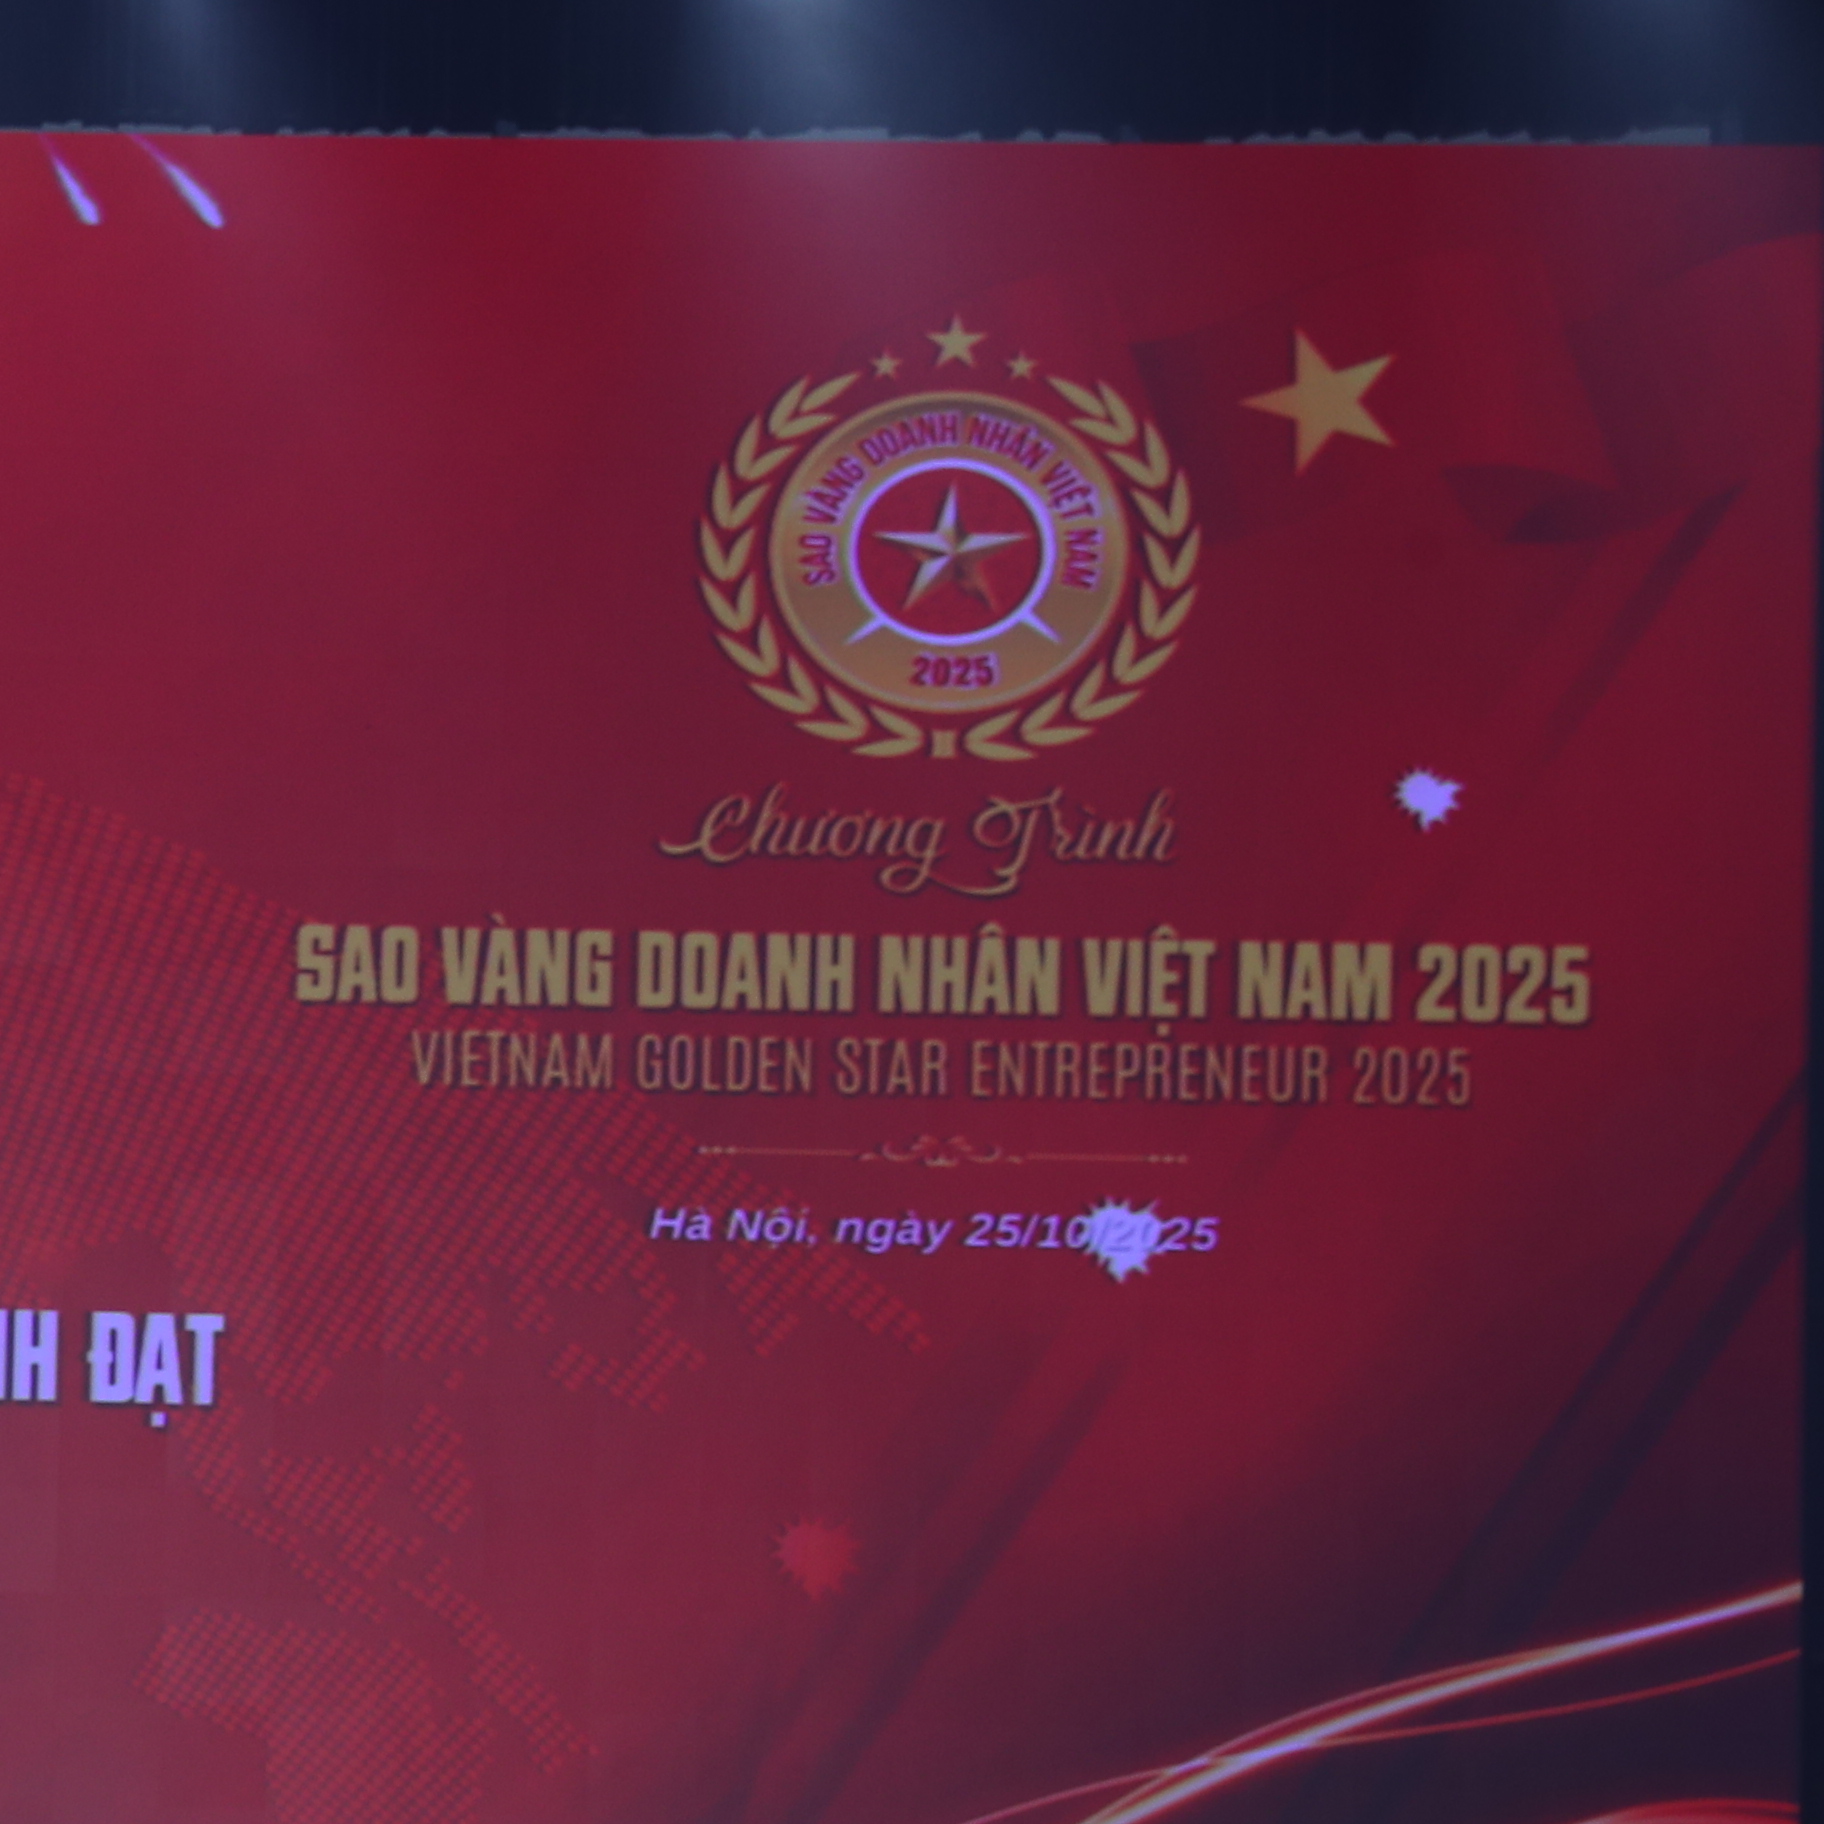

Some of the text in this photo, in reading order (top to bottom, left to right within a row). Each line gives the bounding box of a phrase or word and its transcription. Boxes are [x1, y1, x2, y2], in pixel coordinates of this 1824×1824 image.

[861, 412, 959, 464] DOANH
[968, 415, 1050, 470] NHÂN
[1043, 461, 1096, 521] VIỆT
[799, 533, 836, 587] SAO
[1063, 527, 1103, 591] NAM
[910, 653, 996, 687] 2025
[659, 782, 1176, 892] Chương Trình
[296, 912, 1589, 1036] SAO VÀNG DOANH NHÂN VIỆT NAM 2025
[410, 1030, 1470, 1105] VIETNAM GOLDEN STAR ENTREPRENEUR 2025
[650, 1207, 711, 1241] Hà
[726, 1208, 815, 1247] Nội,
[834, 1209, 952, 1254] ngày
[87, 1311, 224, 1427] ĐẠT
